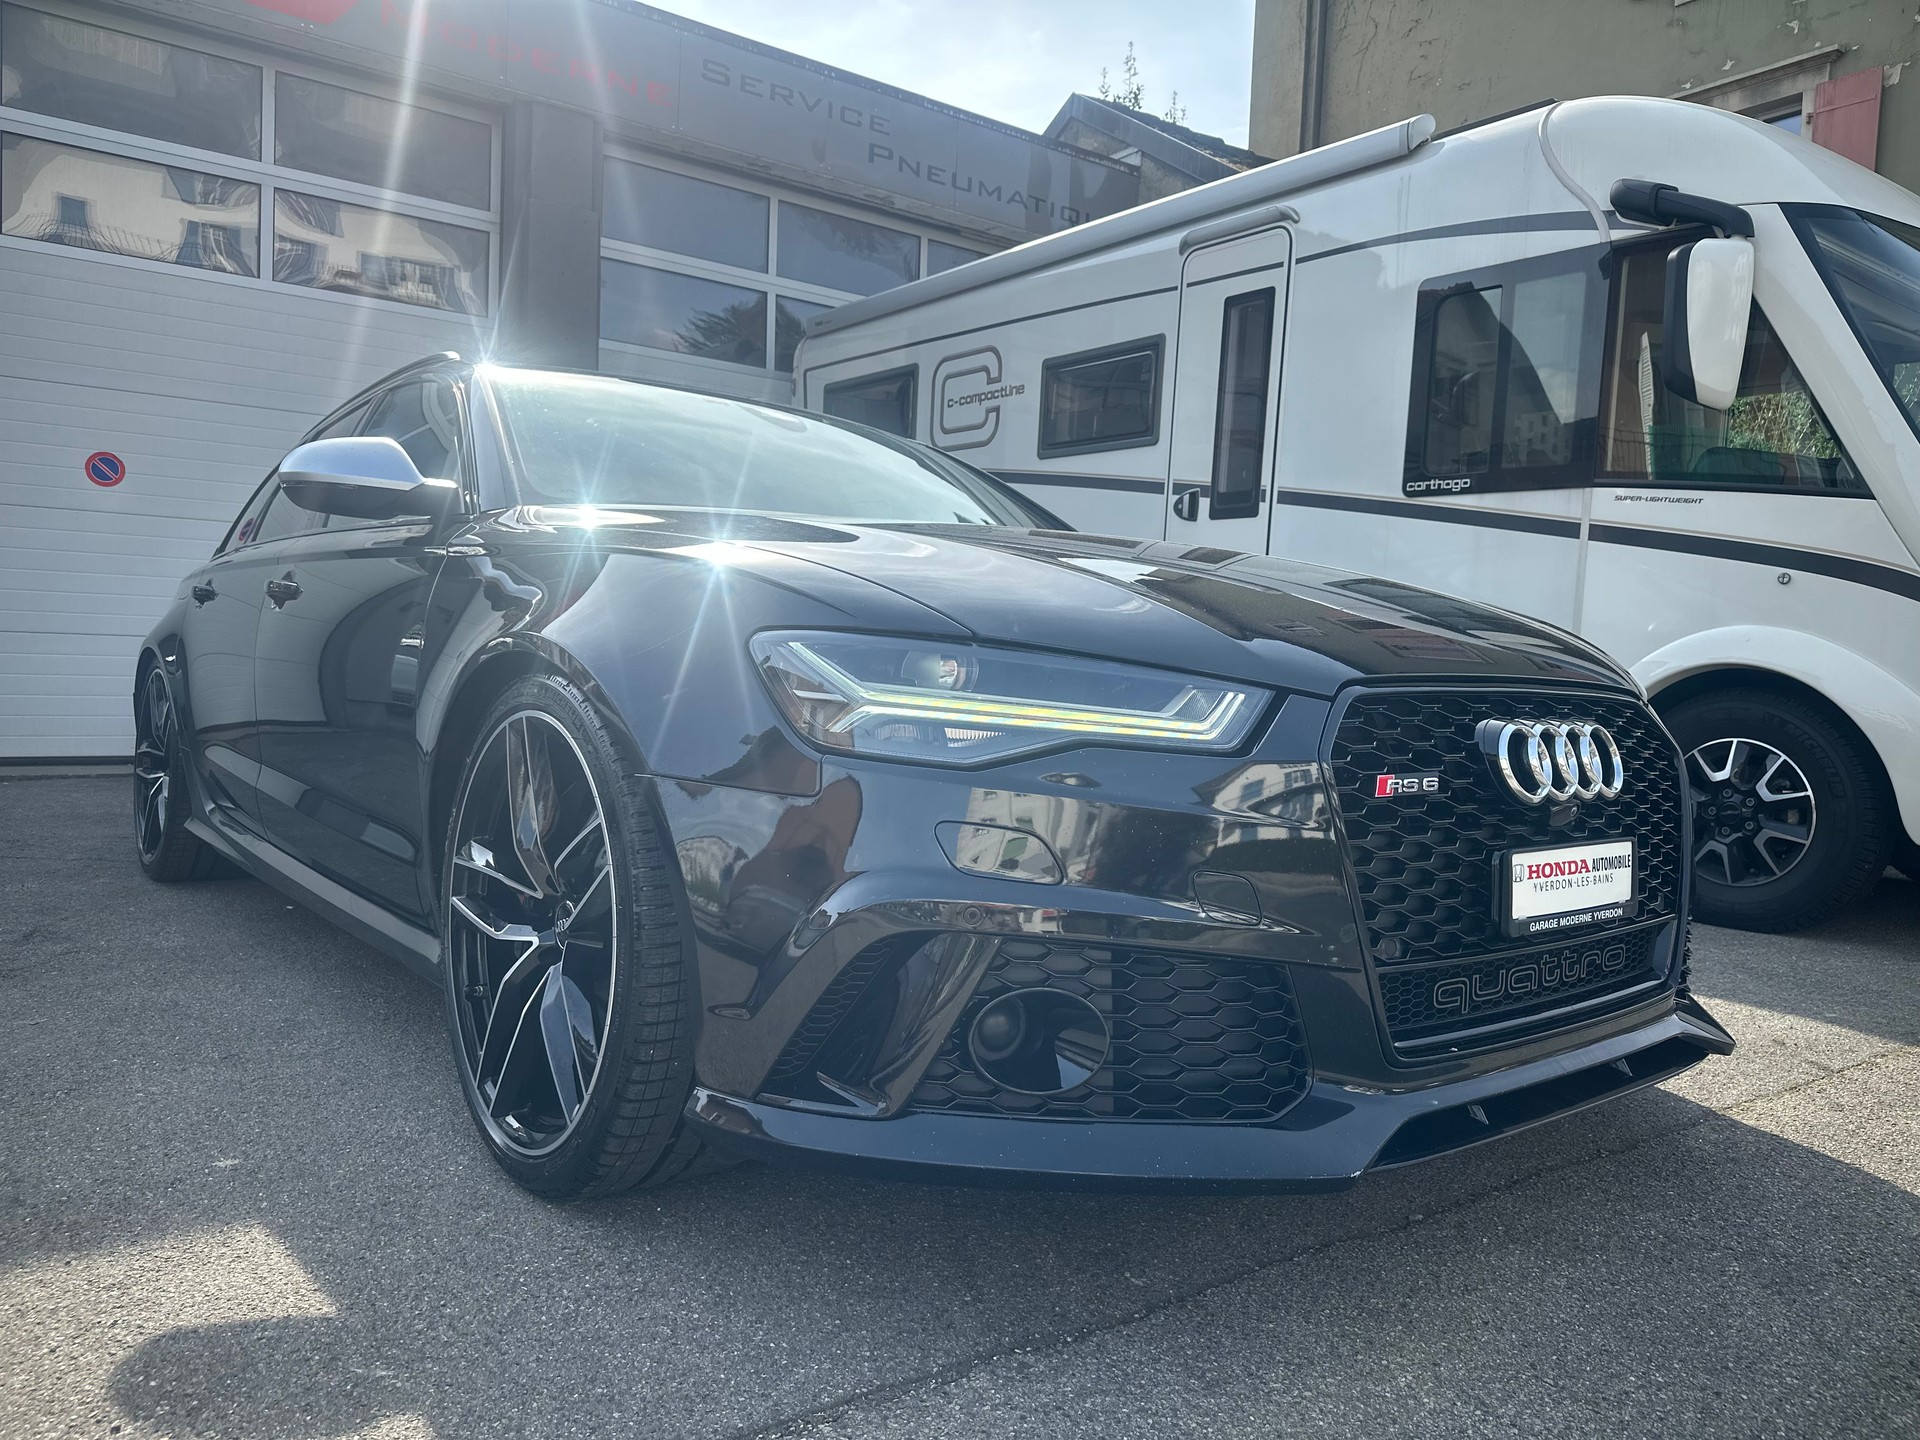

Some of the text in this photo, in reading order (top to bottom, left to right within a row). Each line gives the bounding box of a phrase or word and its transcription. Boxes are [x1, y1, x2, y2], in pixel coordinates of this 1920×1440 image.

[701, 58, 891, 136] SERVICE
[868, 142, 1090, 226] PNEUMATIQ
[1406, 479, 1471, 492] carthago
[1614, 495, 1704, 504] SUPER-LIGHTWEIGHT
[1527, 854, 1631, 880] HONDA AUTOMOBILE
[1533, 873, 1614, 892] YVERDON-LES-BAINS
[1529, 907, 1623, 932] GARAGE MODERNE YVERDON
[1433, 944, 1626, 1014] quattro
